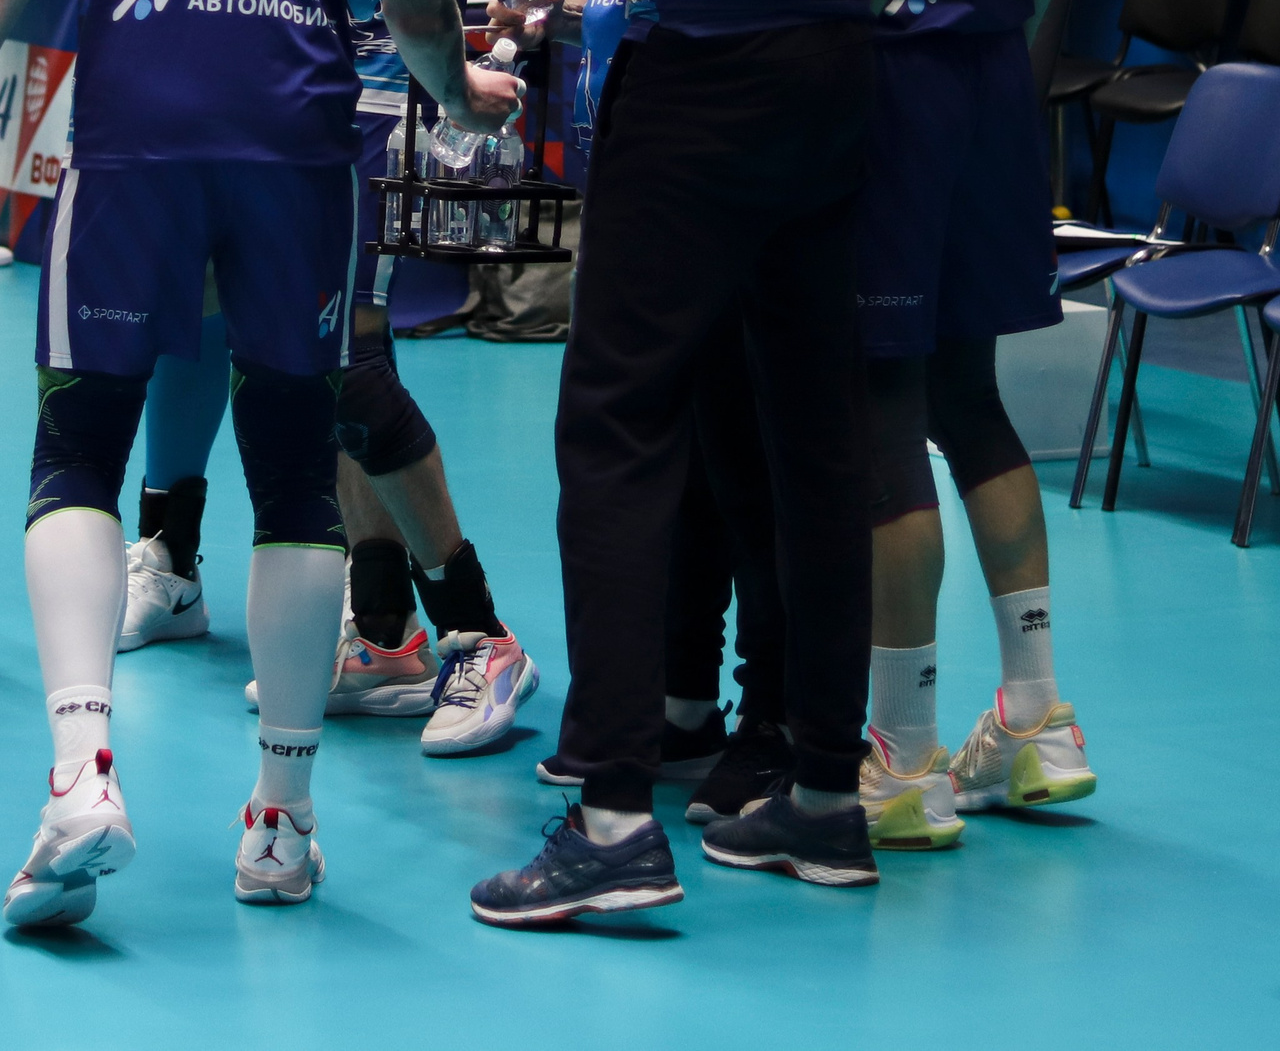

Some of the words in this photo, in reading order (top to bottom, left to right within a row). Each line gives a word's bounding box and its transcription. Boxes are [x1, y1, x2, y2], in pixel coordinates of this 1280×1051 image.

[30, 152, 61, 187] ВФ
[867, 294, 924, 307] SPORTART
[93, 308, 149, 324] SPORTART
